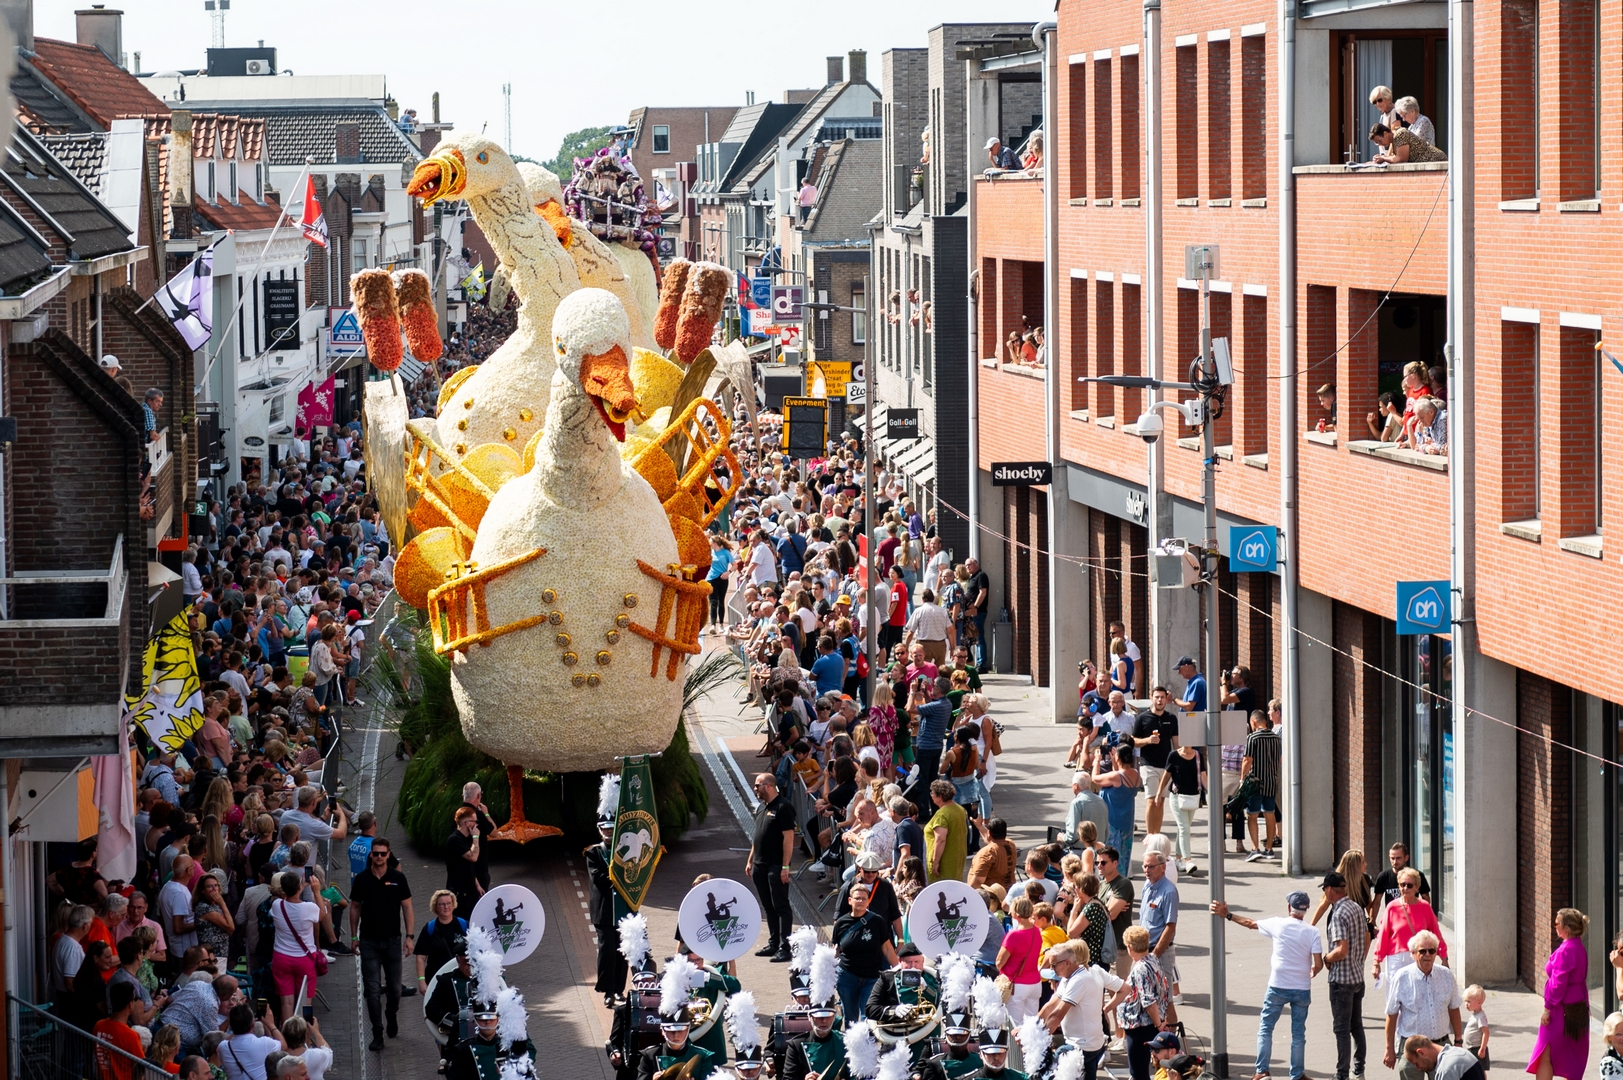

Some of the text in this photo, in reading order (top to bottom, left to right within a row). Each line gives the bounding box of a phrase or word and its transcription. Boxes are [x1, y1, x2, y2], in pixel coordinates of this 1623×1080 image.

[850, 385, 866, 397] Eto
[786, 398, 826, 406] Evenement
[994, 466, 1046, 482] shoeby
